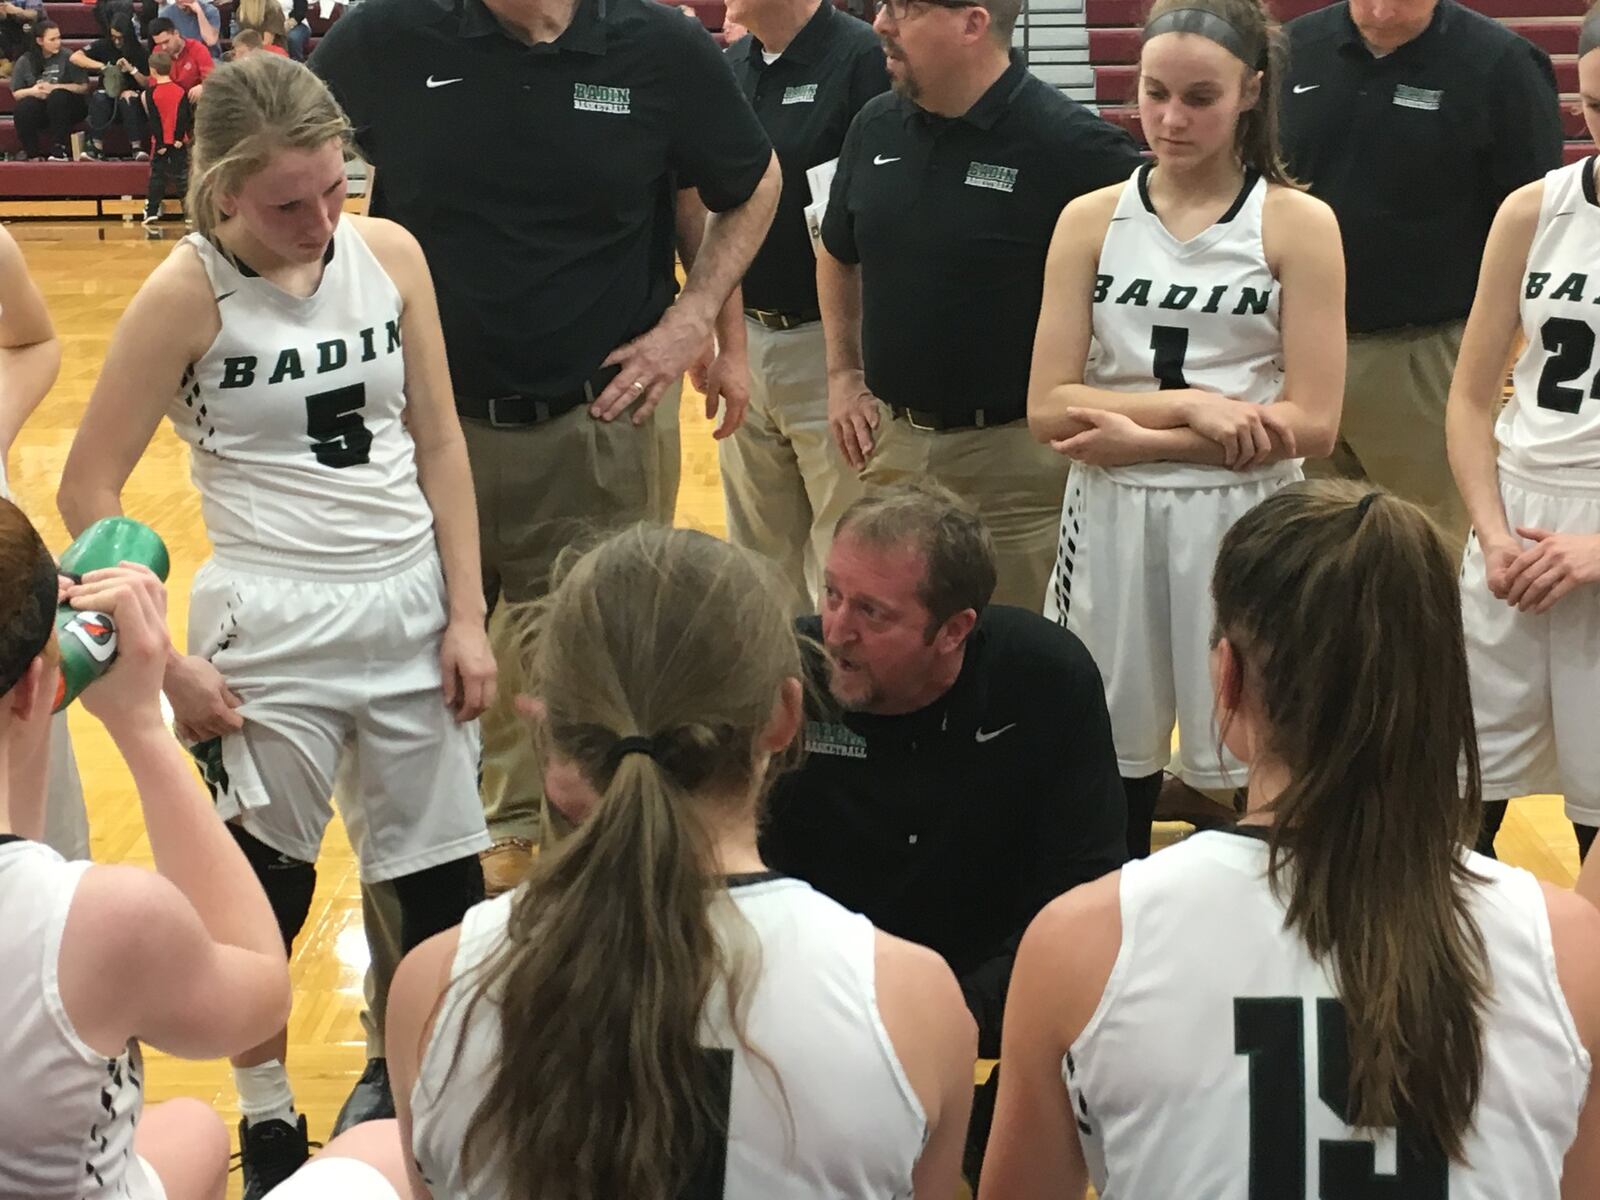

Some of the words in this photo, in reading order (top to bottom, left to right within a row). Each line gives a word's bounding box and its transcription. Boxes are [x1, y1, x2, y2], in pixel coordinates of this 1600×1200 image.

[574, 83, 630, 104] BADIN
[1093, 274, 1271, 315] BADIN
[1525, 272, 1600, 304] BA
[1150, 325, 1190, 390] 1
[1537, 317, 1600, 414] 2
[305, 382, 373, 469] 5
